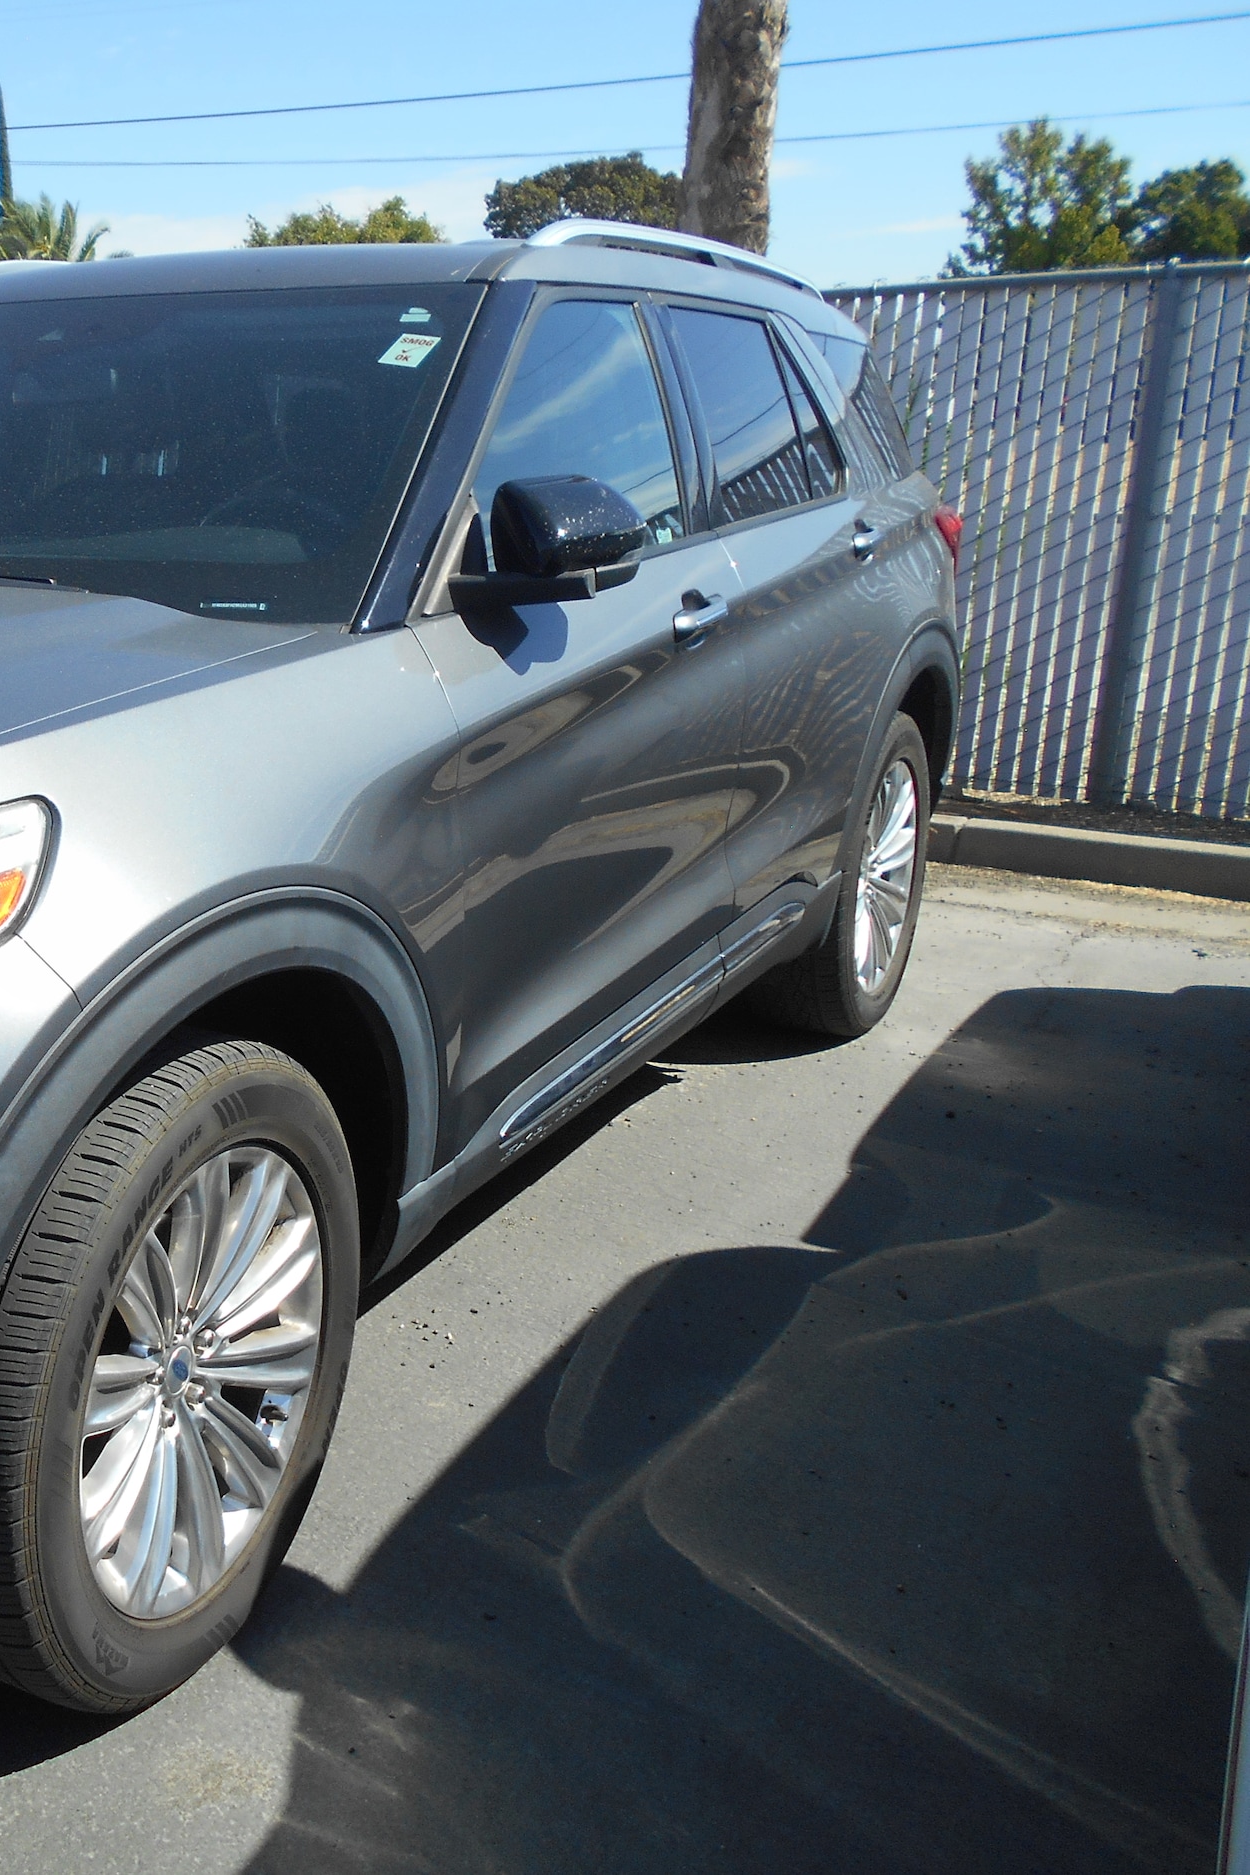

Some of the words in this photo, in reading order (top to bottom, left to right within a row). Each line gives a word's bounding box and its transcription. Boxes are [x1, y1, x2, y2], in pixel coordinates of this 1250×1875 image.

[400, 337, 435, 347] SMOG
[395, 354, 411, 362] OK
[107, 1156, 174, 1287] RANGE
